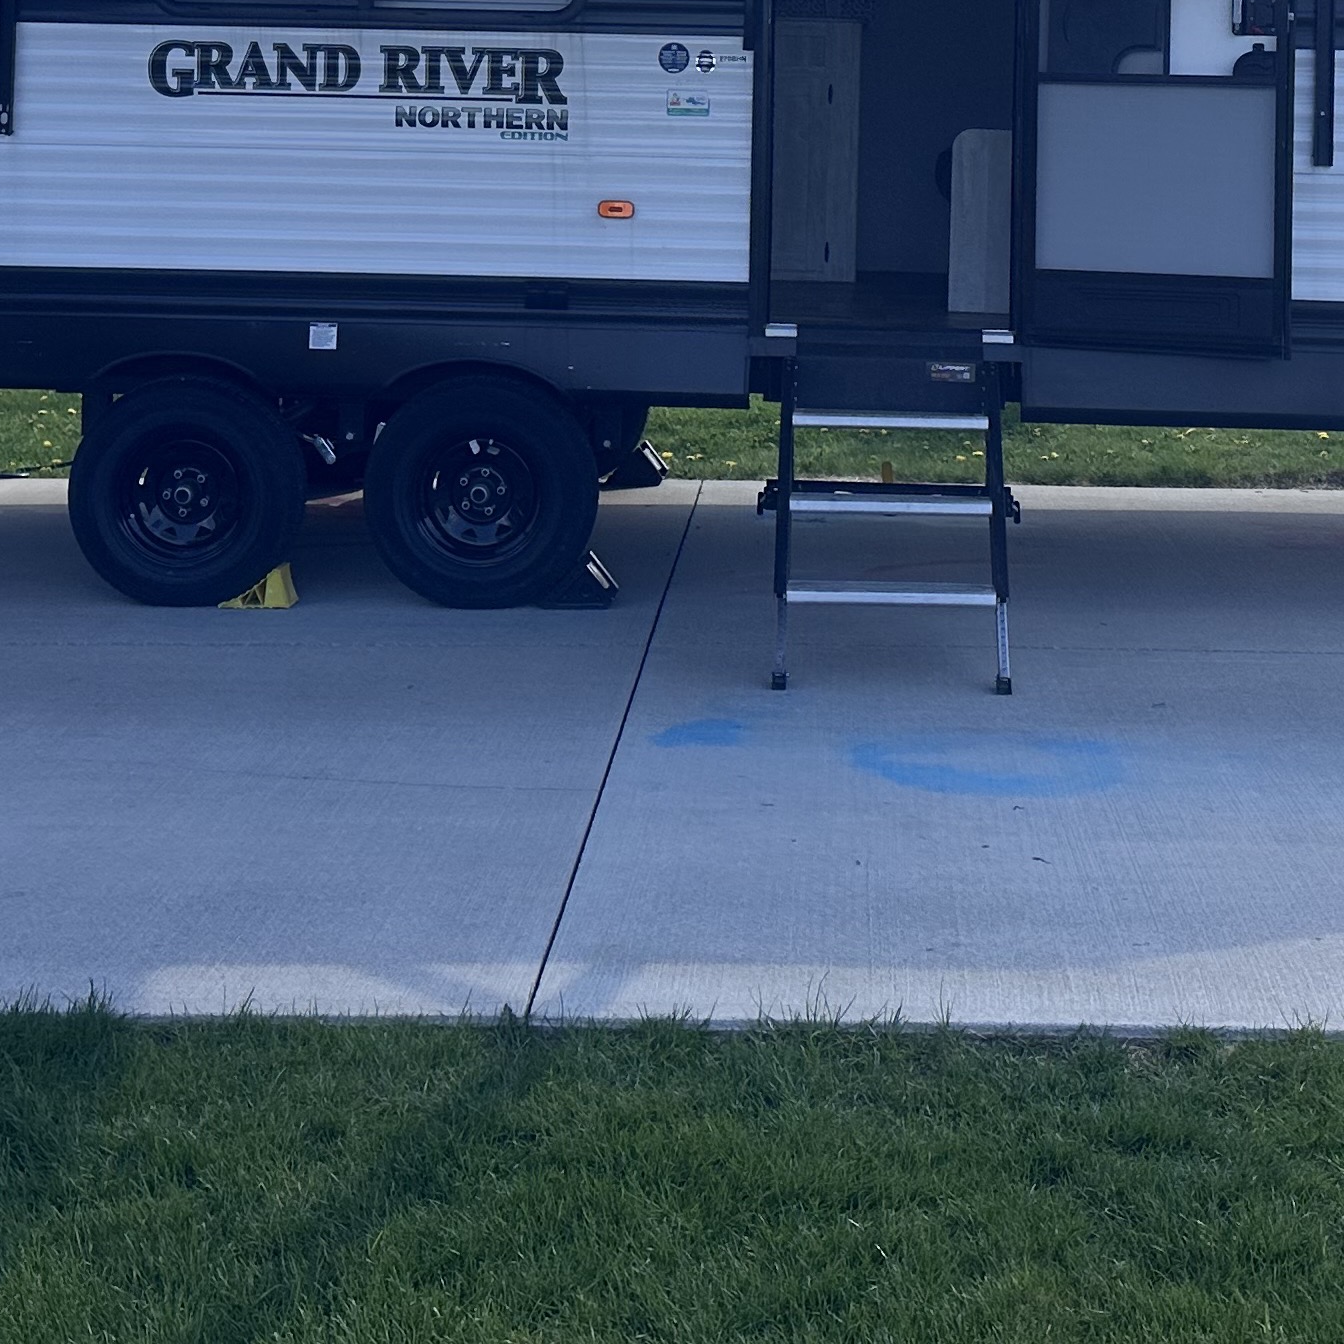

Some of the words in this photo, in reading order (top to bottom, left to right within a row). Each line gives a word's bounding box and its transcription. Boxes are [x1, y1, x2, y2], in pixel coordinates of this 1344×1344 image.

[148, 39, 361, 97] GRAND
[379, 45, 568, 105] RIVER
[395, 106, 568, 130] NORTHERN
[500, 131, 568, 141] EDITION
